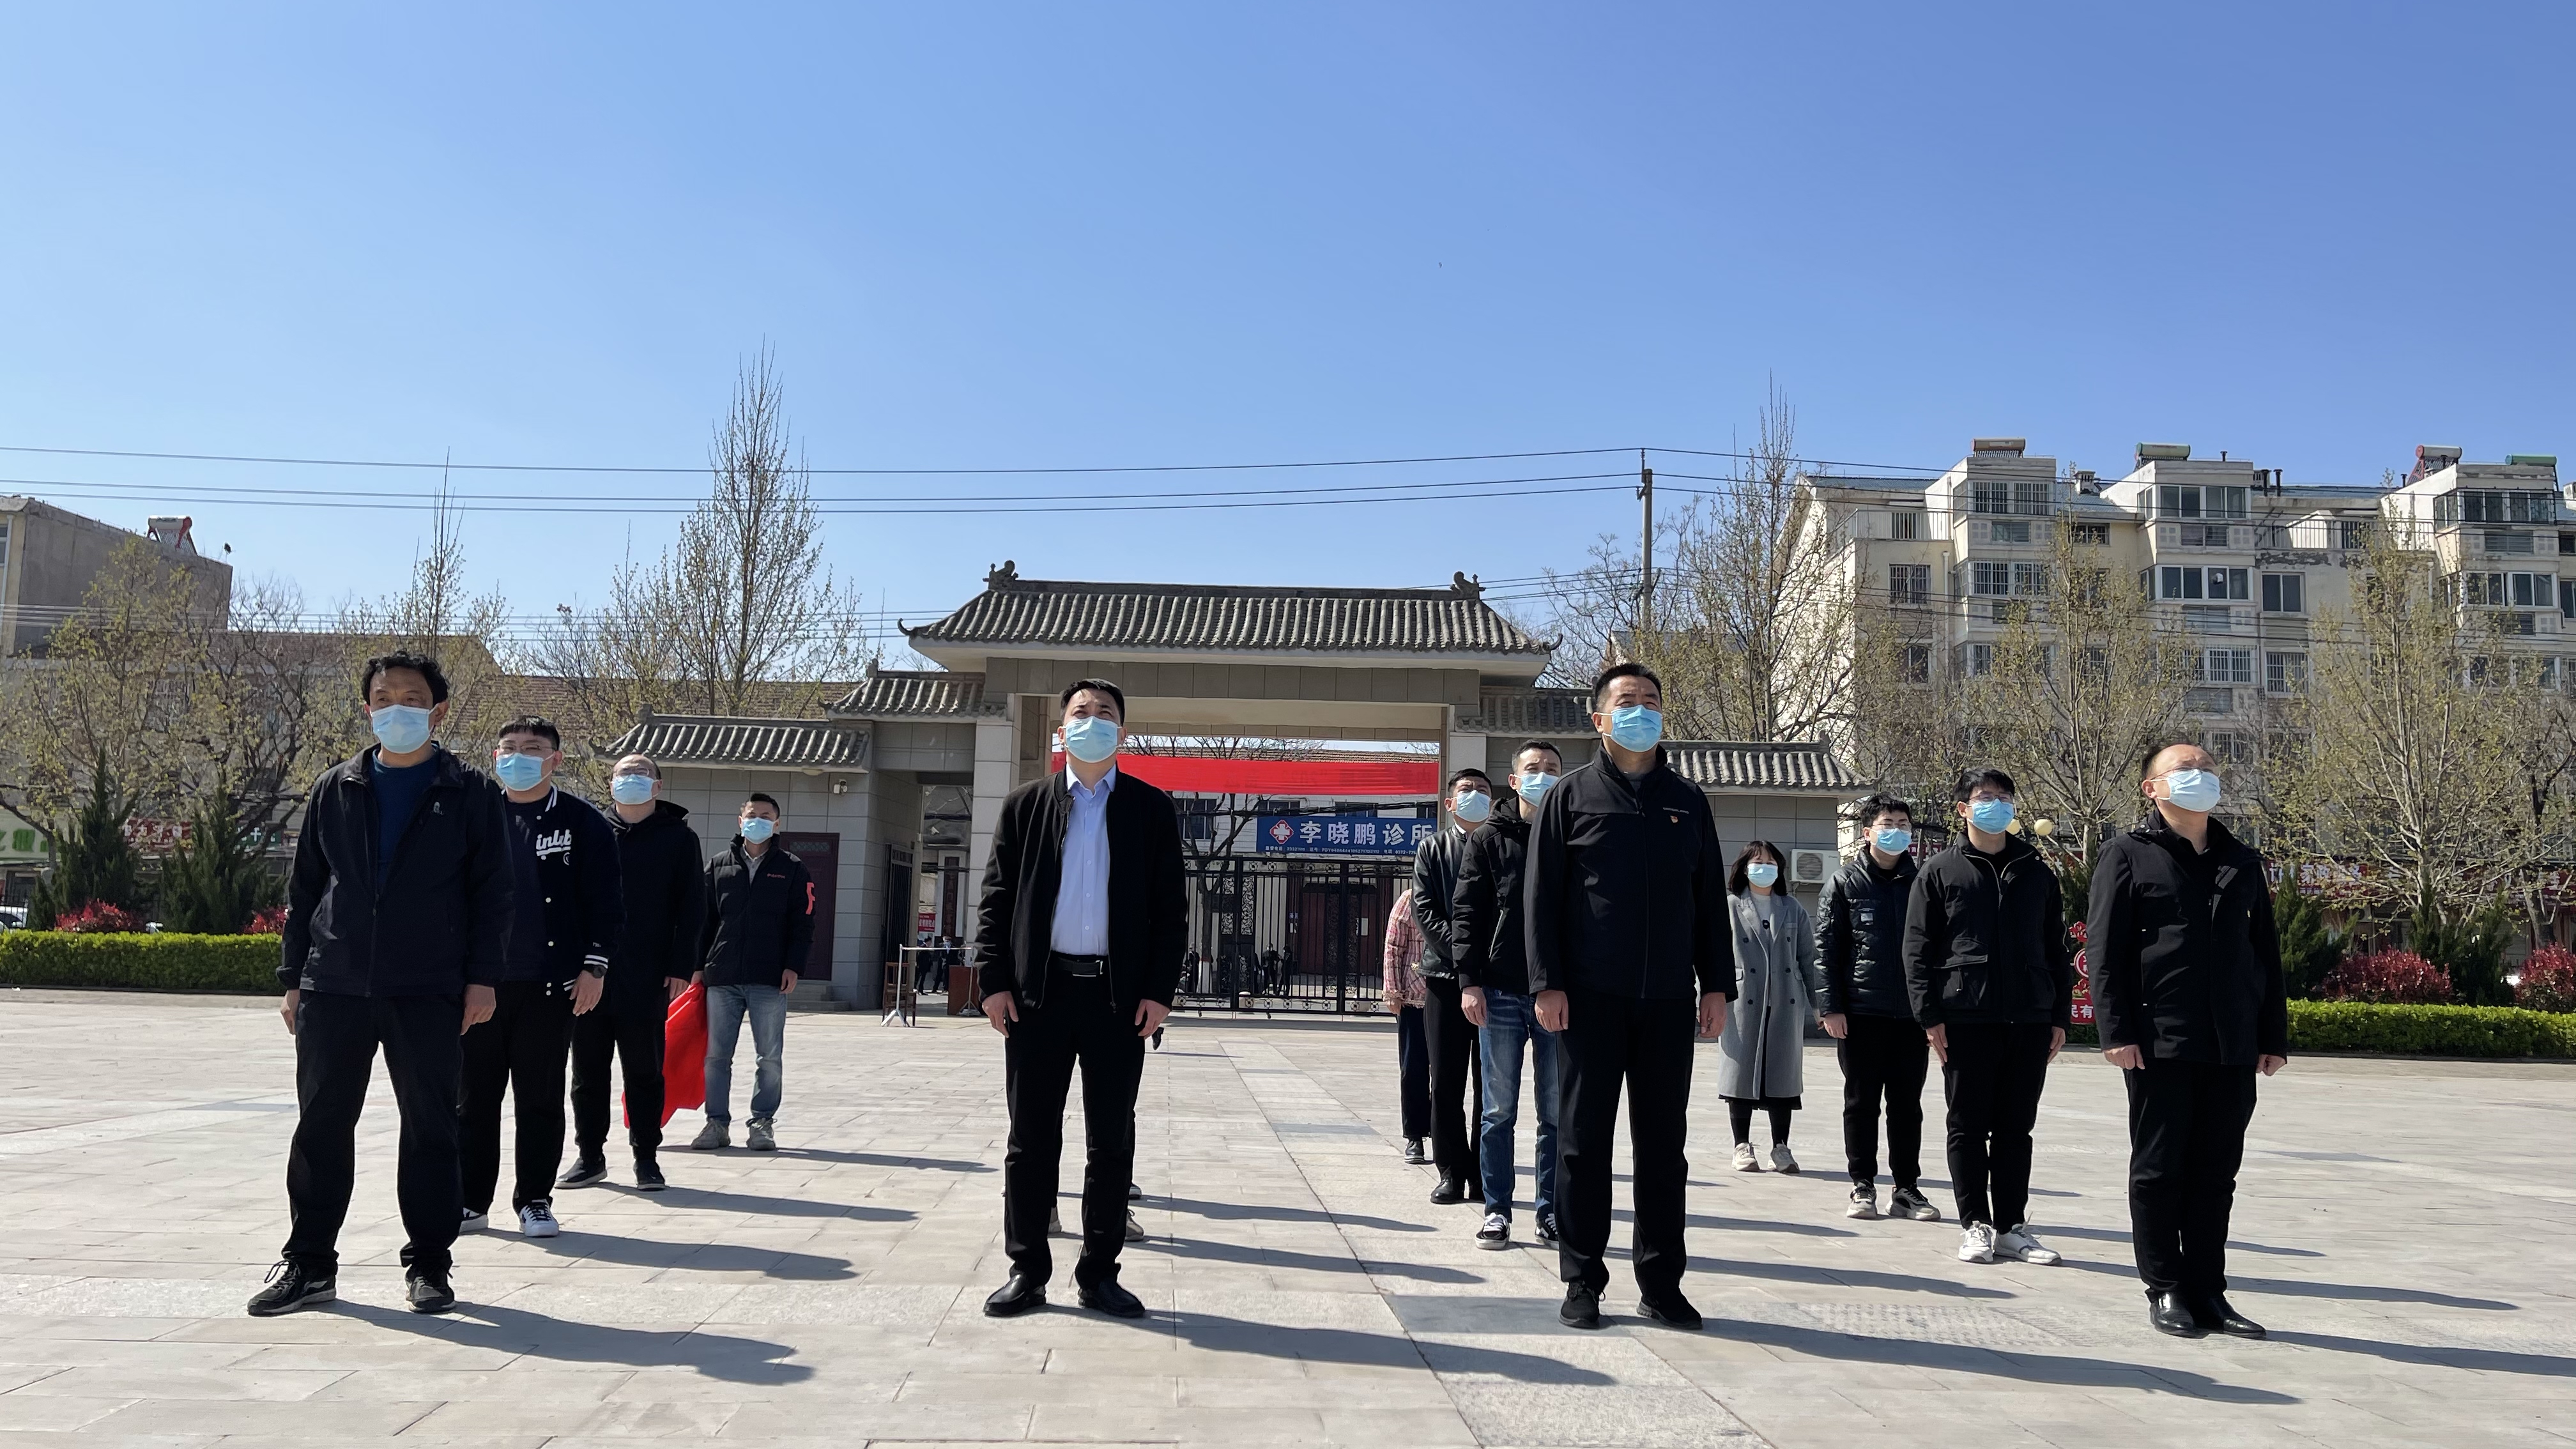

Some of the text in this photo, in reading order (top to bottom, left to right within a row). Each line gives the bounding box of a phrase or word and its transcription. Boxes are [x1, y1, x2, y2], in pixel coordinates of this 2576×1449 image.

[1300, 820, 1432, 846] 李晓鹏诊所
